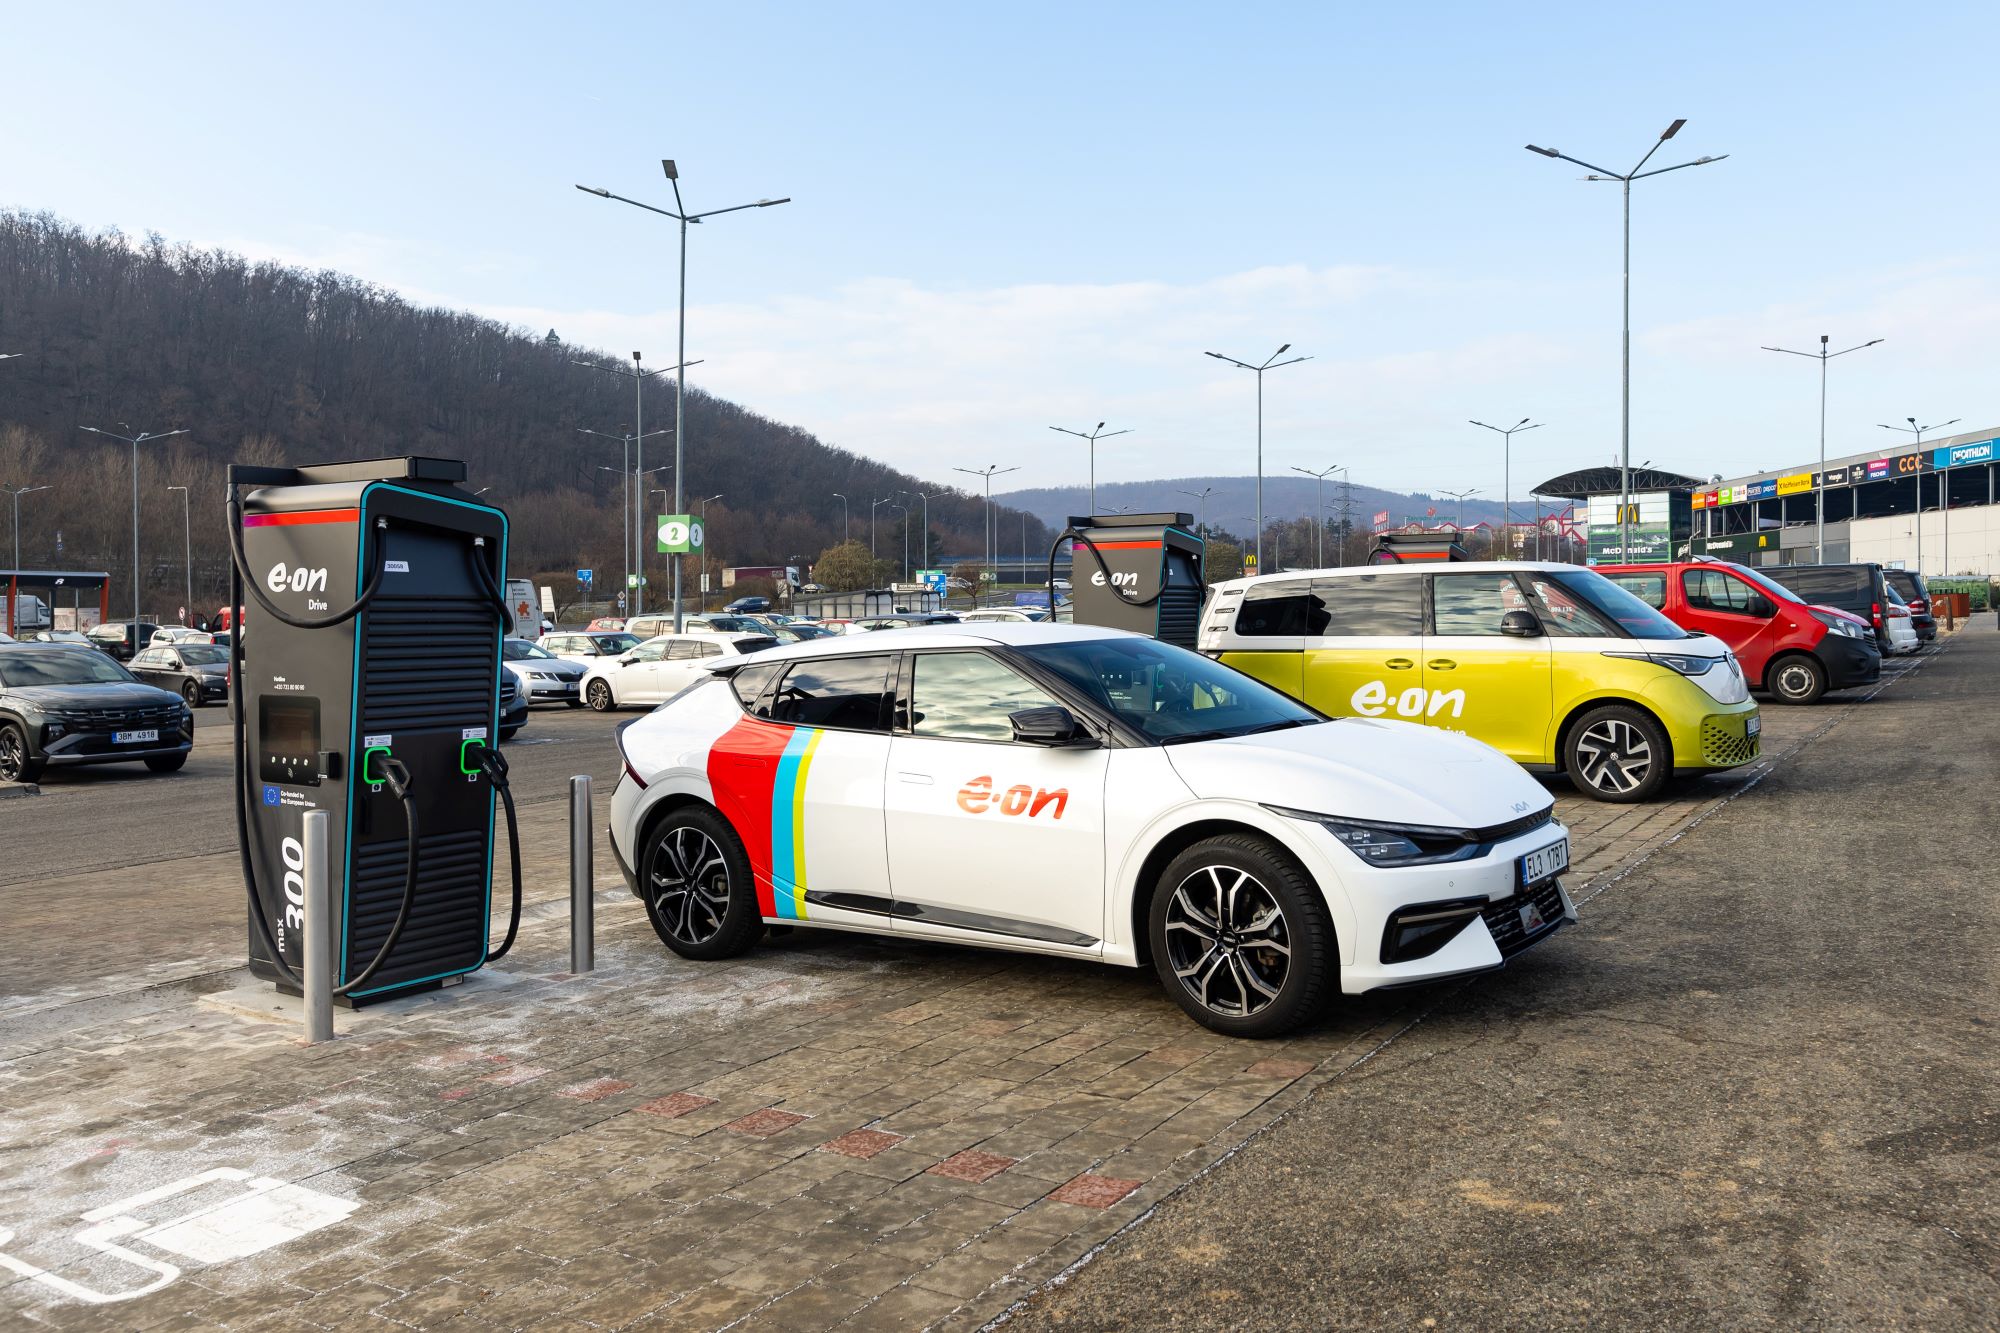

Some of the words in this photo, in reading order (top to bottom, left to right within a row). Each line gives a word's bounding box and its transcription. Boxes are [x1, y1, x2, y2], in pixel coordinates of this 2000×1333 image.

[1953, 445, 1990, 461] DECATHLON
[1899, 455, 1922, 472] CCC
[670, 527, 678, 540] 2
[1602, 546, 1653, 555] McDnald's
[308, 599, 328, 610] Drive
[118, 732, 132, 740] 3BM
[280, 790, 300, 799] Co-funded
[1527, 854, 1543, 879] EL3
[277, 918, 285, 953] max
